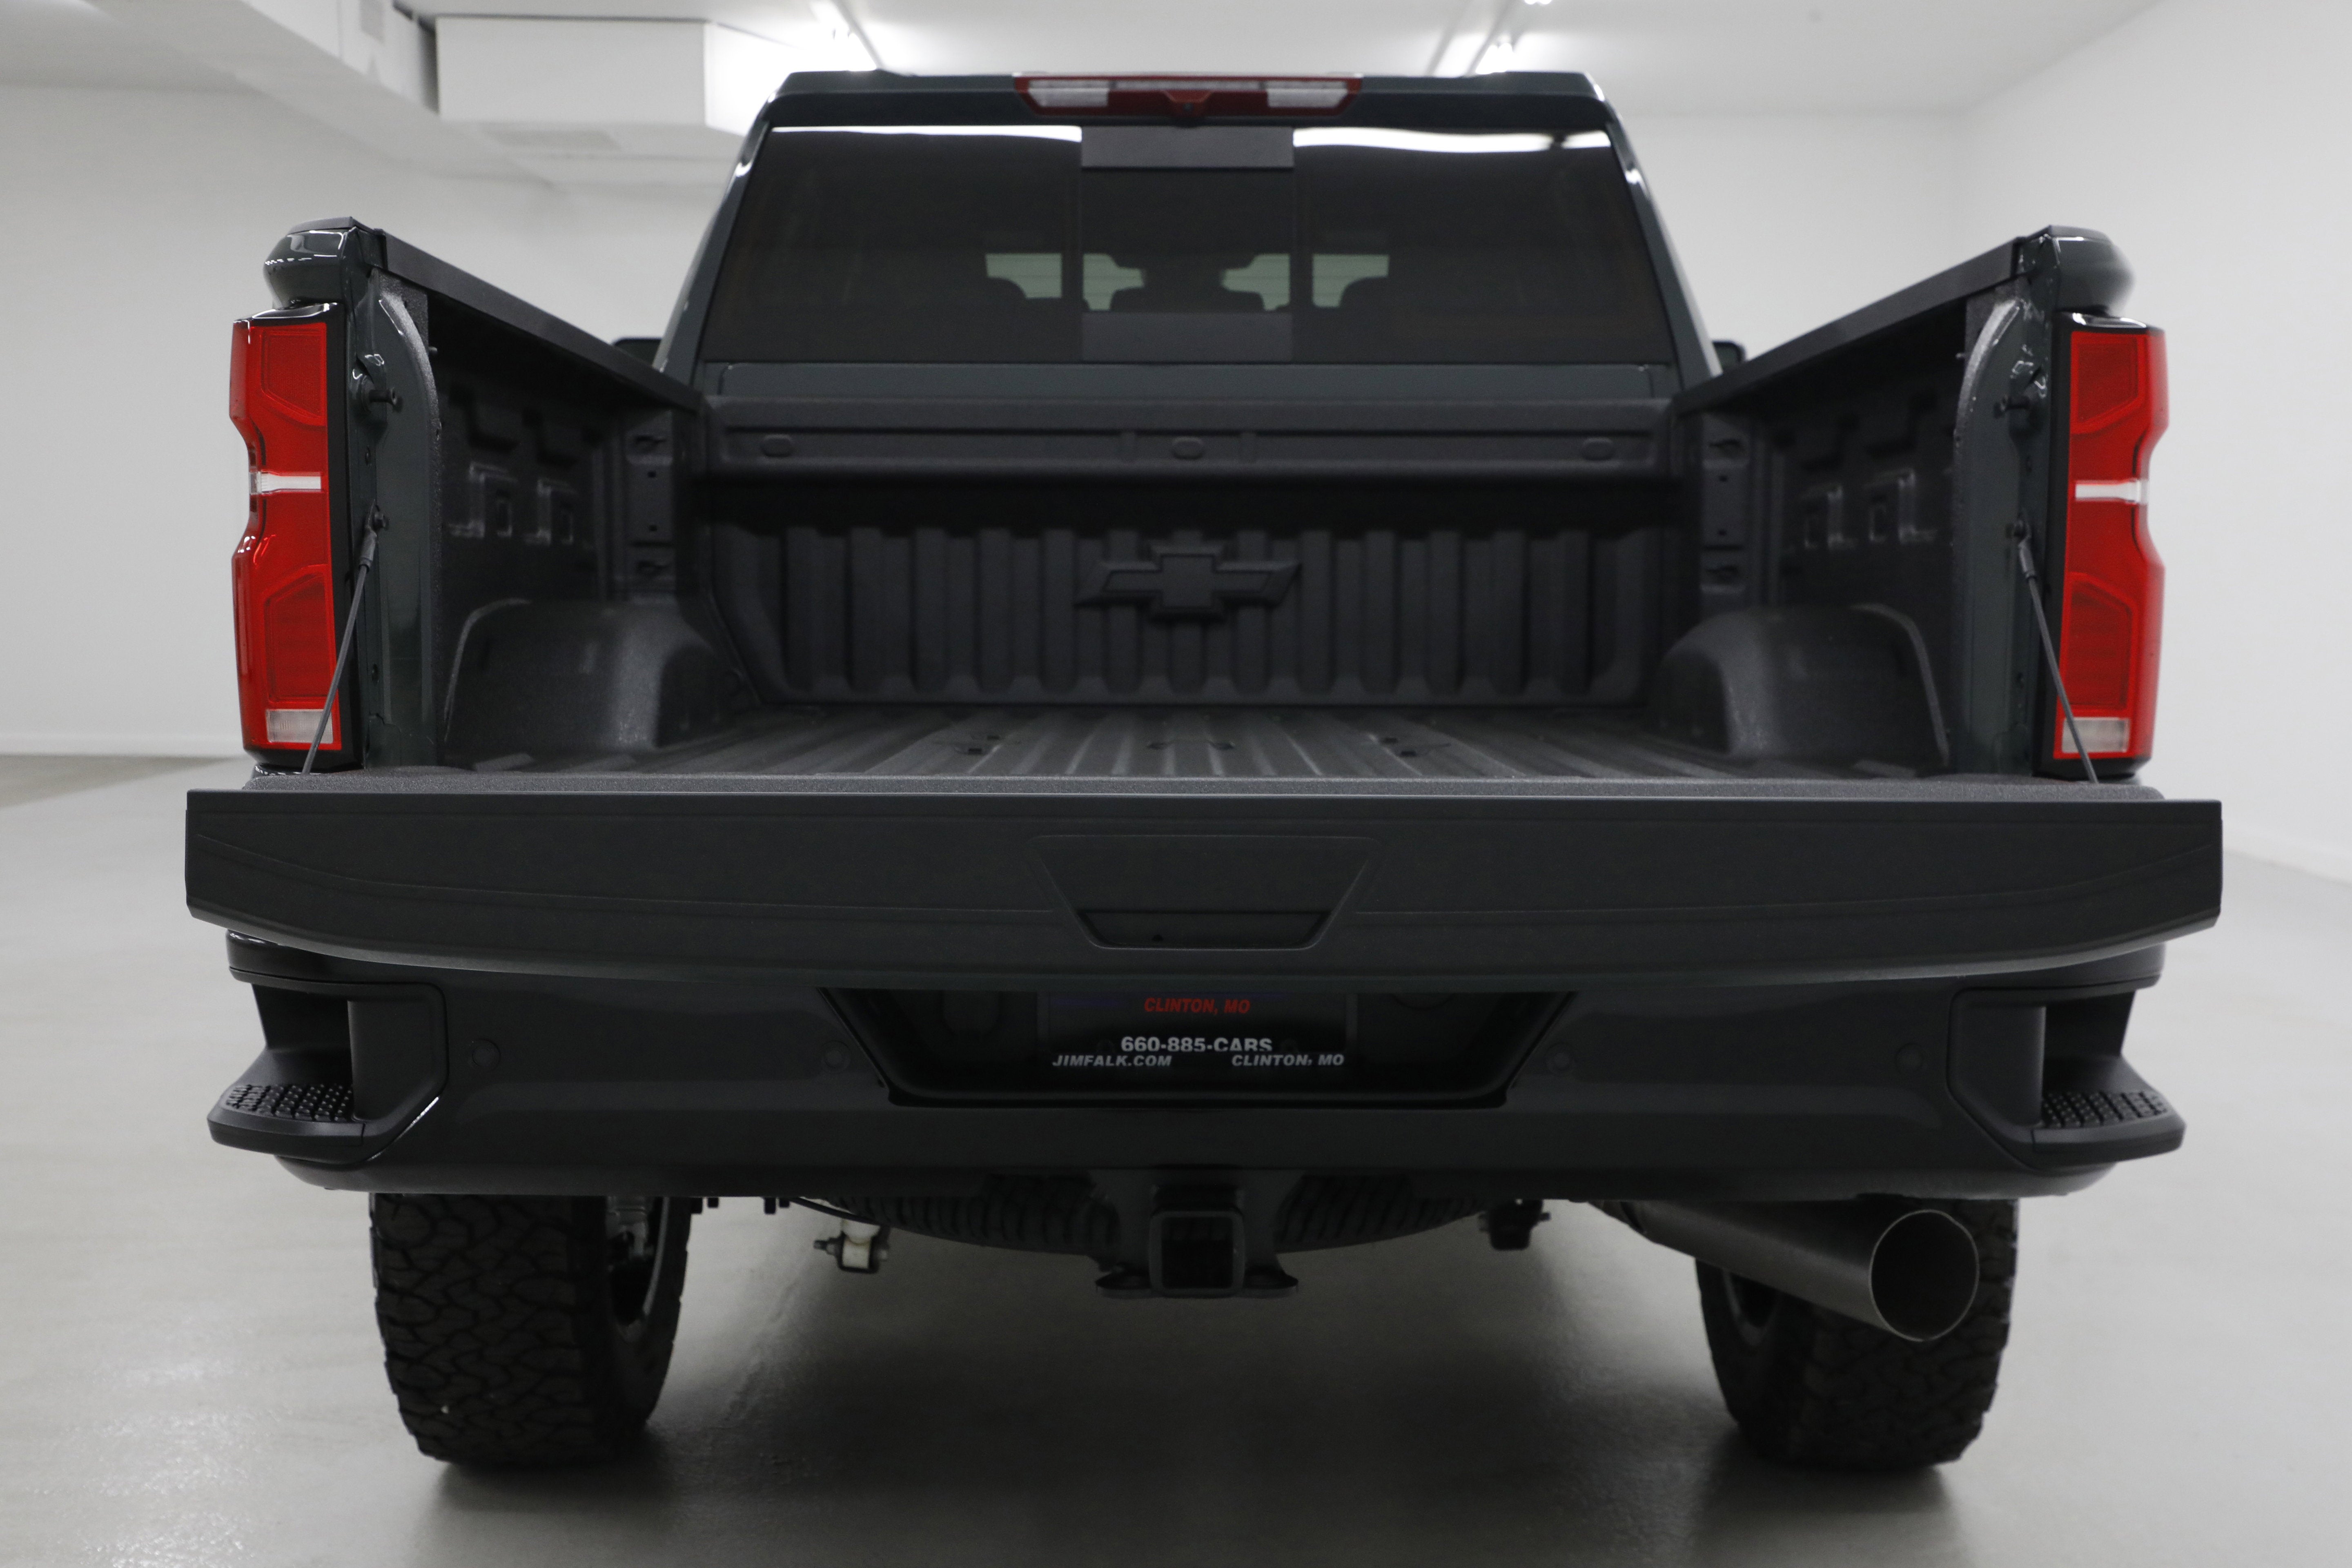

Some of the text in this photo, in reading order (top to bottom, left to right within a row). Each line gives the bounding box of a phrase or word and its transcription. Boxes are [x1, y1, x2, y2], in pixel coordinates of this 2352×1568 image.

[1144, 997, 1251, 1015] CLINTON, MO
[1121, 1036, 1273, 1052] 660-885-CARS
[1052, 1054, 1173, 1067] JIMFALK.COM
[1231, 1053, 1345, 1067] CLINTON, MO
